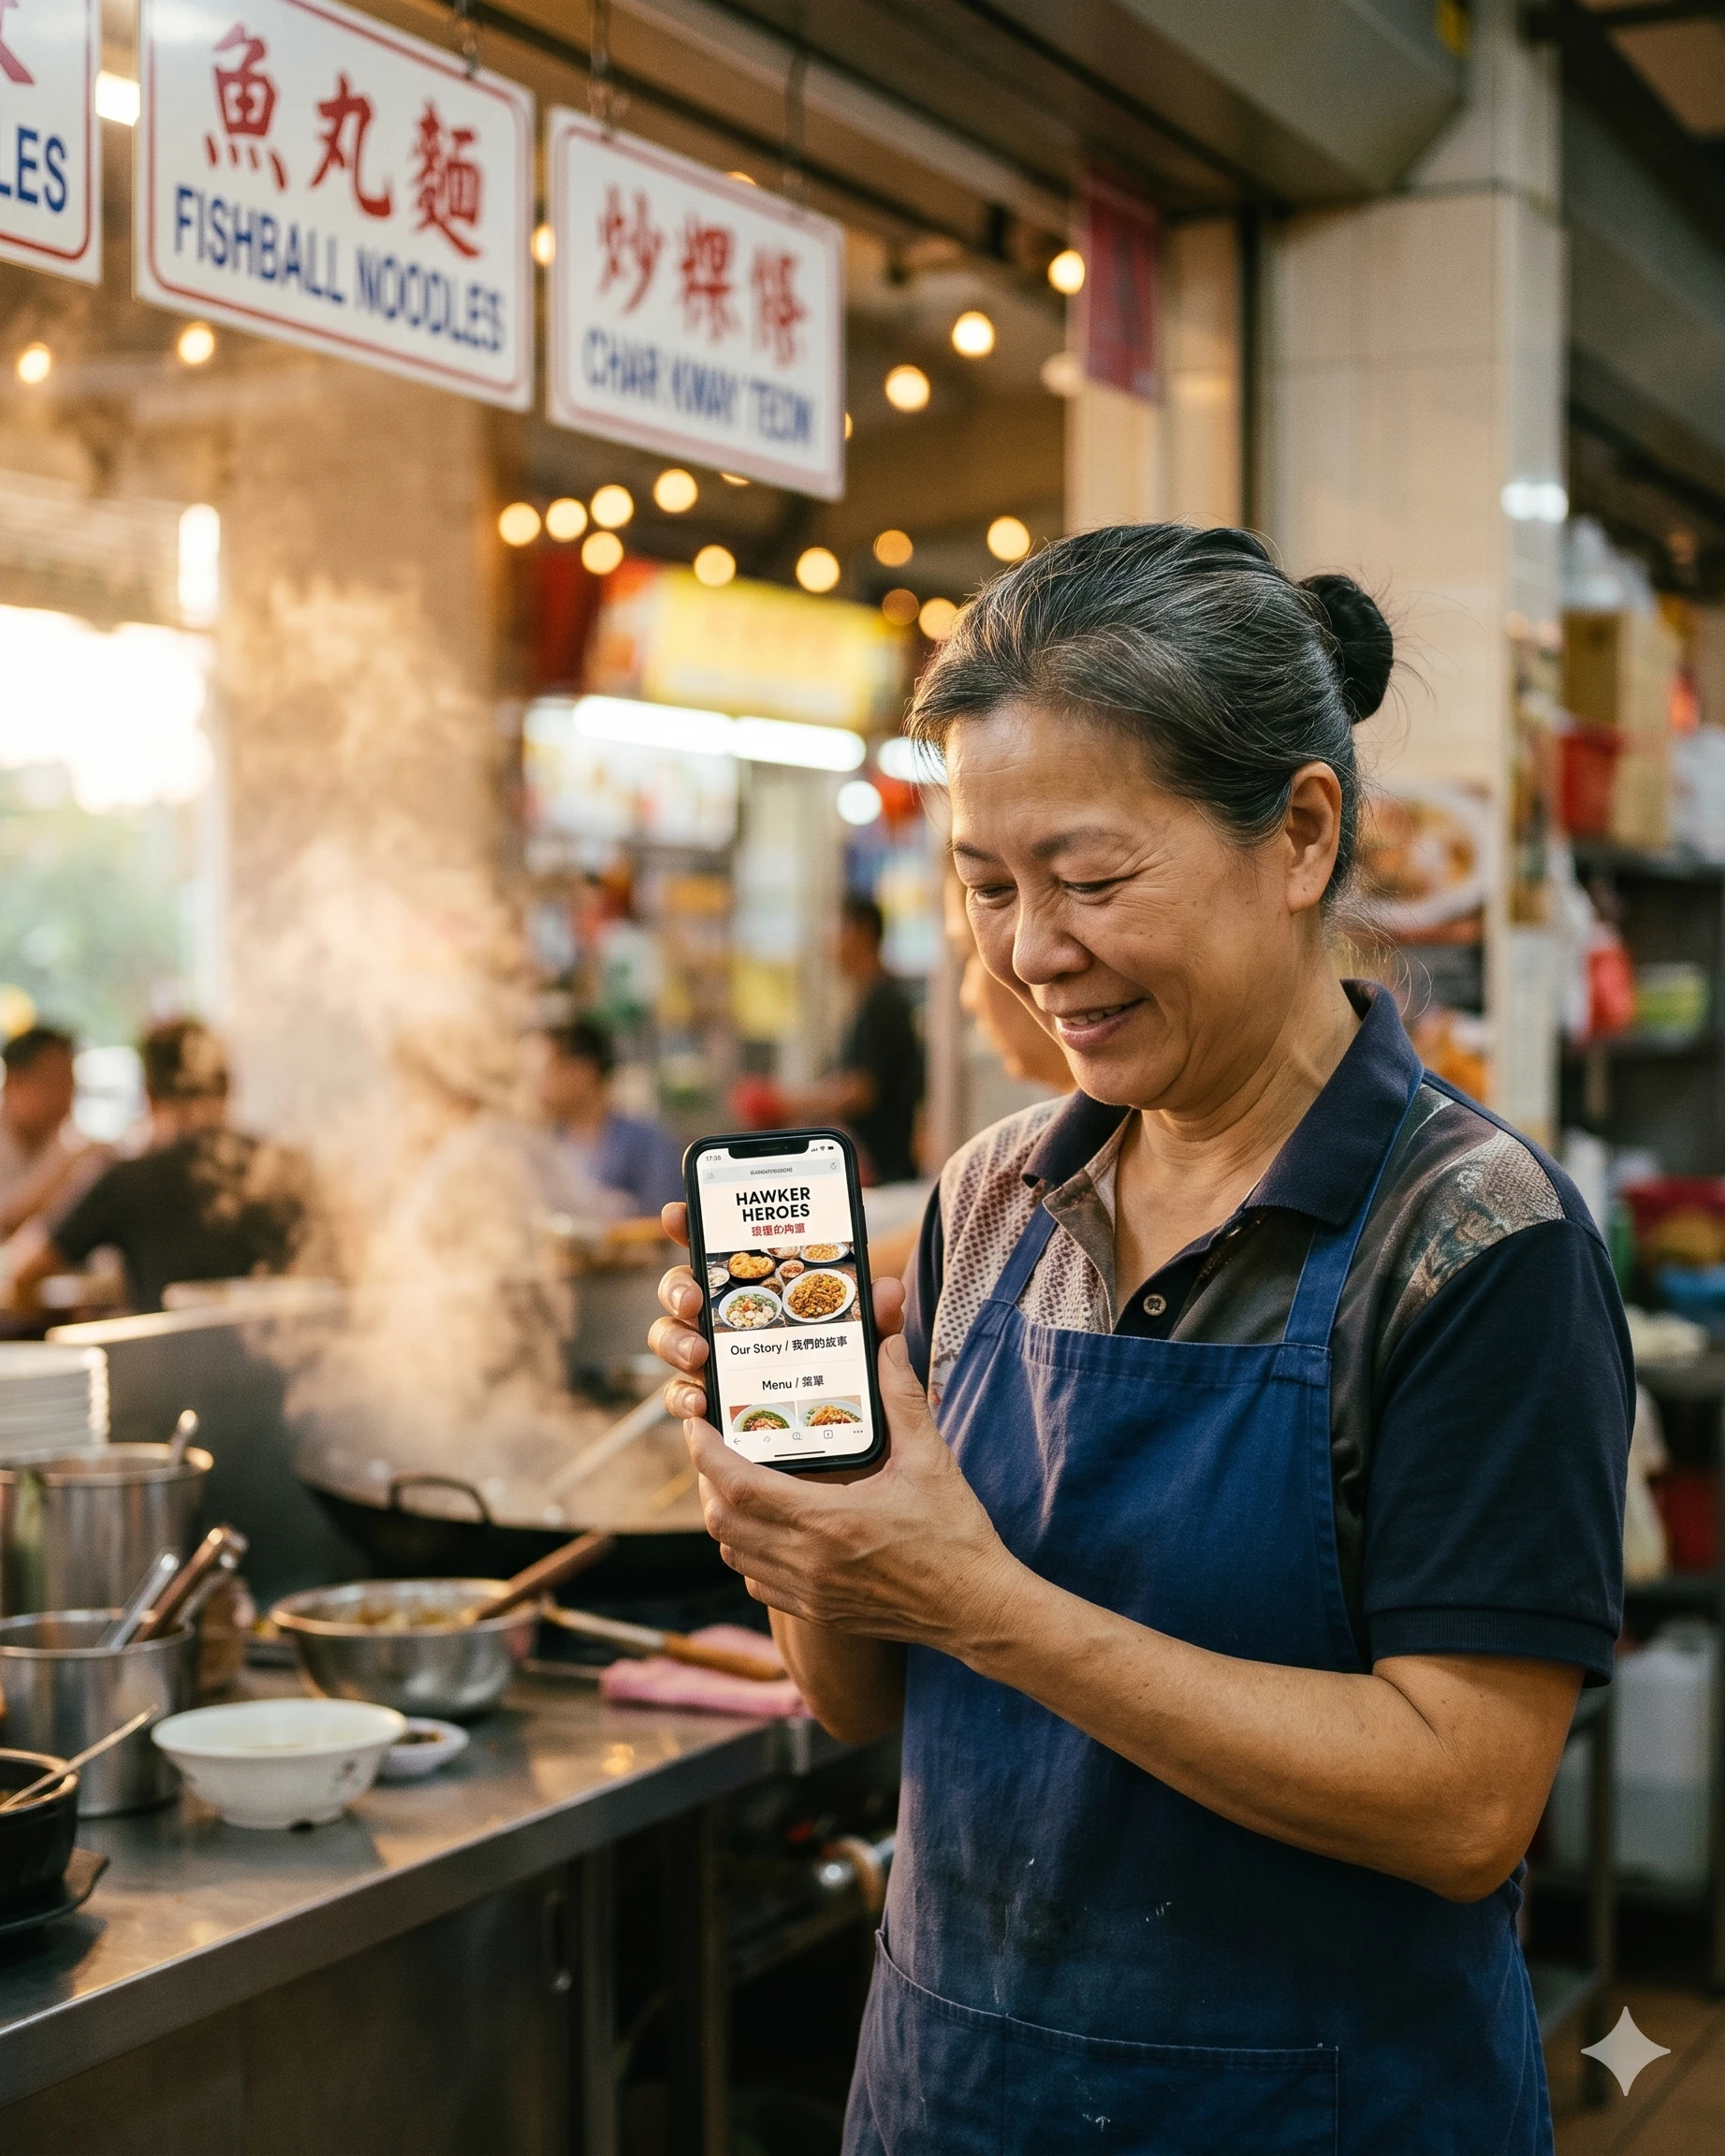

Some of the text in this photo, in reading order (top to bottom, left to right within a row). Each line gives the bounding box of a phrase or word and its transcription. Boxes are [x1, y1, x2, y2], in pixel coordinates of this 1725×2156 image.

[204, 22, 481, 258] 魚丸麵
[175, 185, 502, 354] FISHBALL NOODLES
[736, 1187, 811, 1206] HAWKER
[742, 1203, 811, 1222] HEROES
[730, 1345, 751, 1355] Our
[753, 1343, 782, 1354] Story
[762, 1380, 792, 1391] Menu
